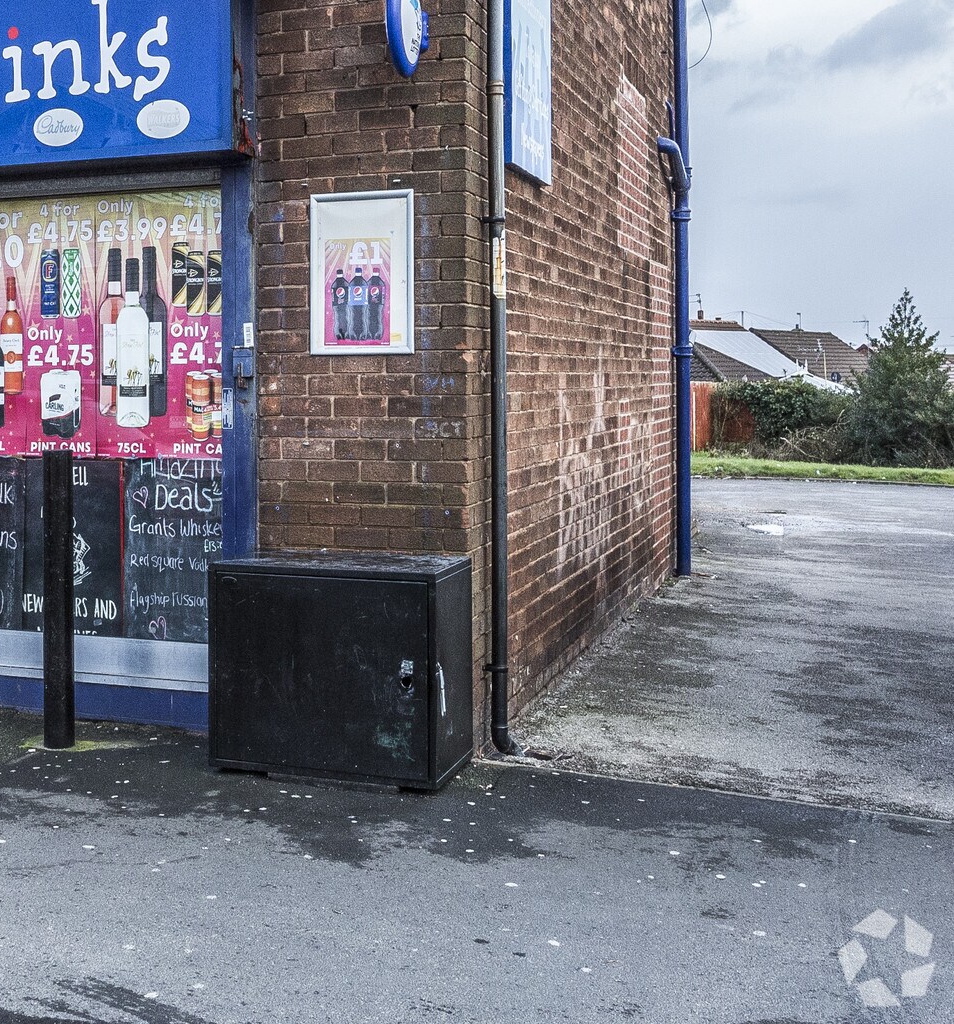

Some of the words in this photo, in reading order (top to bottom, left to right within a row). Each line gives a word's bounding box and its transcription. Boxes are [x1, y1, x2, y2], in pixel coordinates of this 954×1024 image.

[35, 115, 80, 137] Cadbury
[40, 203, 49, 217] 4
[53, 201, 80, 216] for
[97, 198, 134, 215] Only
[183, 194, 194, 208] 4
[199, 193, 222, 208] fo
[27, 220, 93, 243] £4.75
[97, 216, 168, 242] £3.99
[169, 213, 222, 238] £4.7
[329, 241, 346, 251] Only
[349, 241, 383, 265] £1
[27, 326, 63, 343] Only
[169, 323, 209, 341] Only
[27, 344, 94, 367] £4.75
[169, 342, 222, 365] £4.7
[45, 402, 65, 412] CARLING
[30, 441, 57, 453] PINT
[59, 441, 91, 453] CANS
[117, 442, 147, 454] 75CL
[173, 443, 201, 455] PINT
[204, 443, 222, 455] CA
[73, 466, 88, 486] ELL
[154, 482, 213, 512] Deals
[129, 514, 175, 538] Grants
[180, 518, 222, 537] Whiske
[131, 553, 150, 568] Red
[150, 555, 185, 573] square
[189, 556, 209, 572] Vodk
[94, 599, 117, 619] AND
